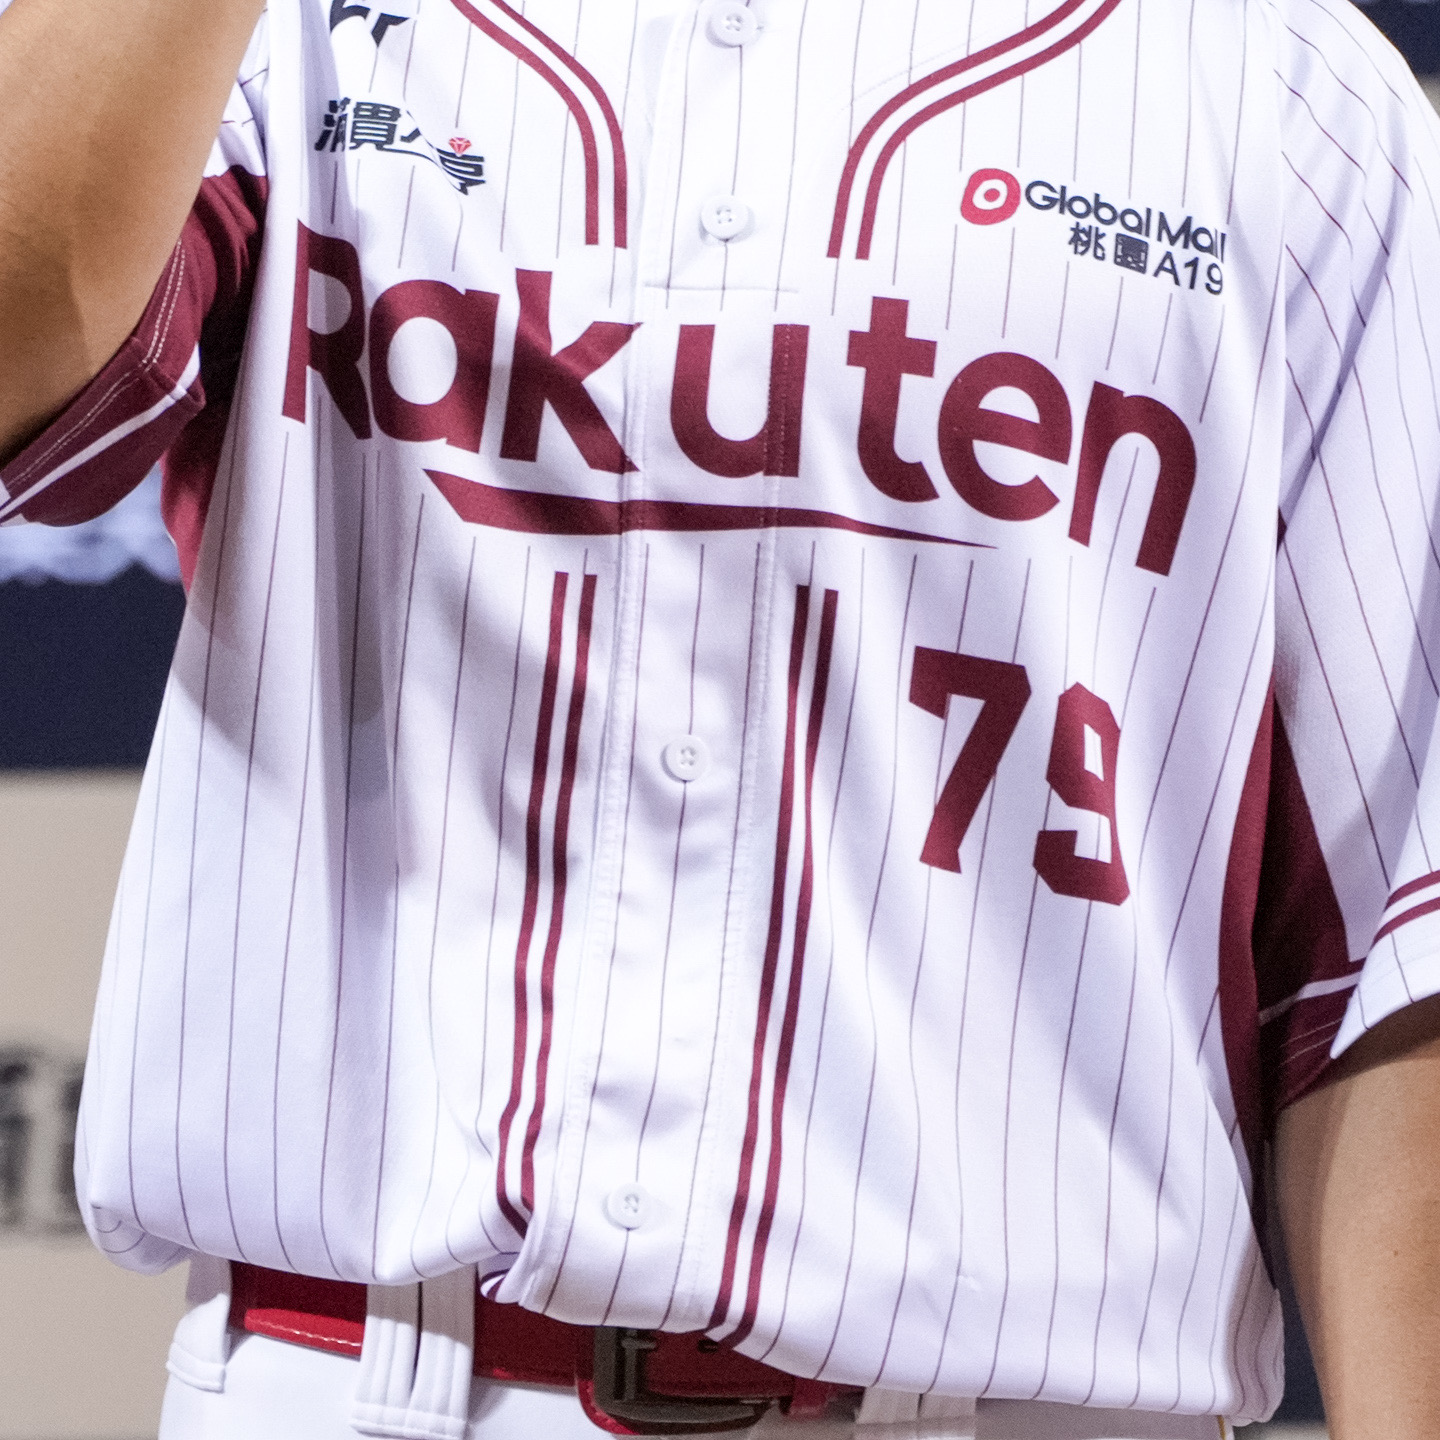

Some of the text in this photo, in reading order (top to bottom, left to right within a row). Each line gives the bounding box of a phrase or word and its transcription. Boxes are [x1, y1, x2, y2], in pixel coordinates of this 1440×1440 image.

[1023, 179, 1152, 238] Global
[281, 216, 1200, 579] Rakuten
[908, 644, 1131, 908] 79
